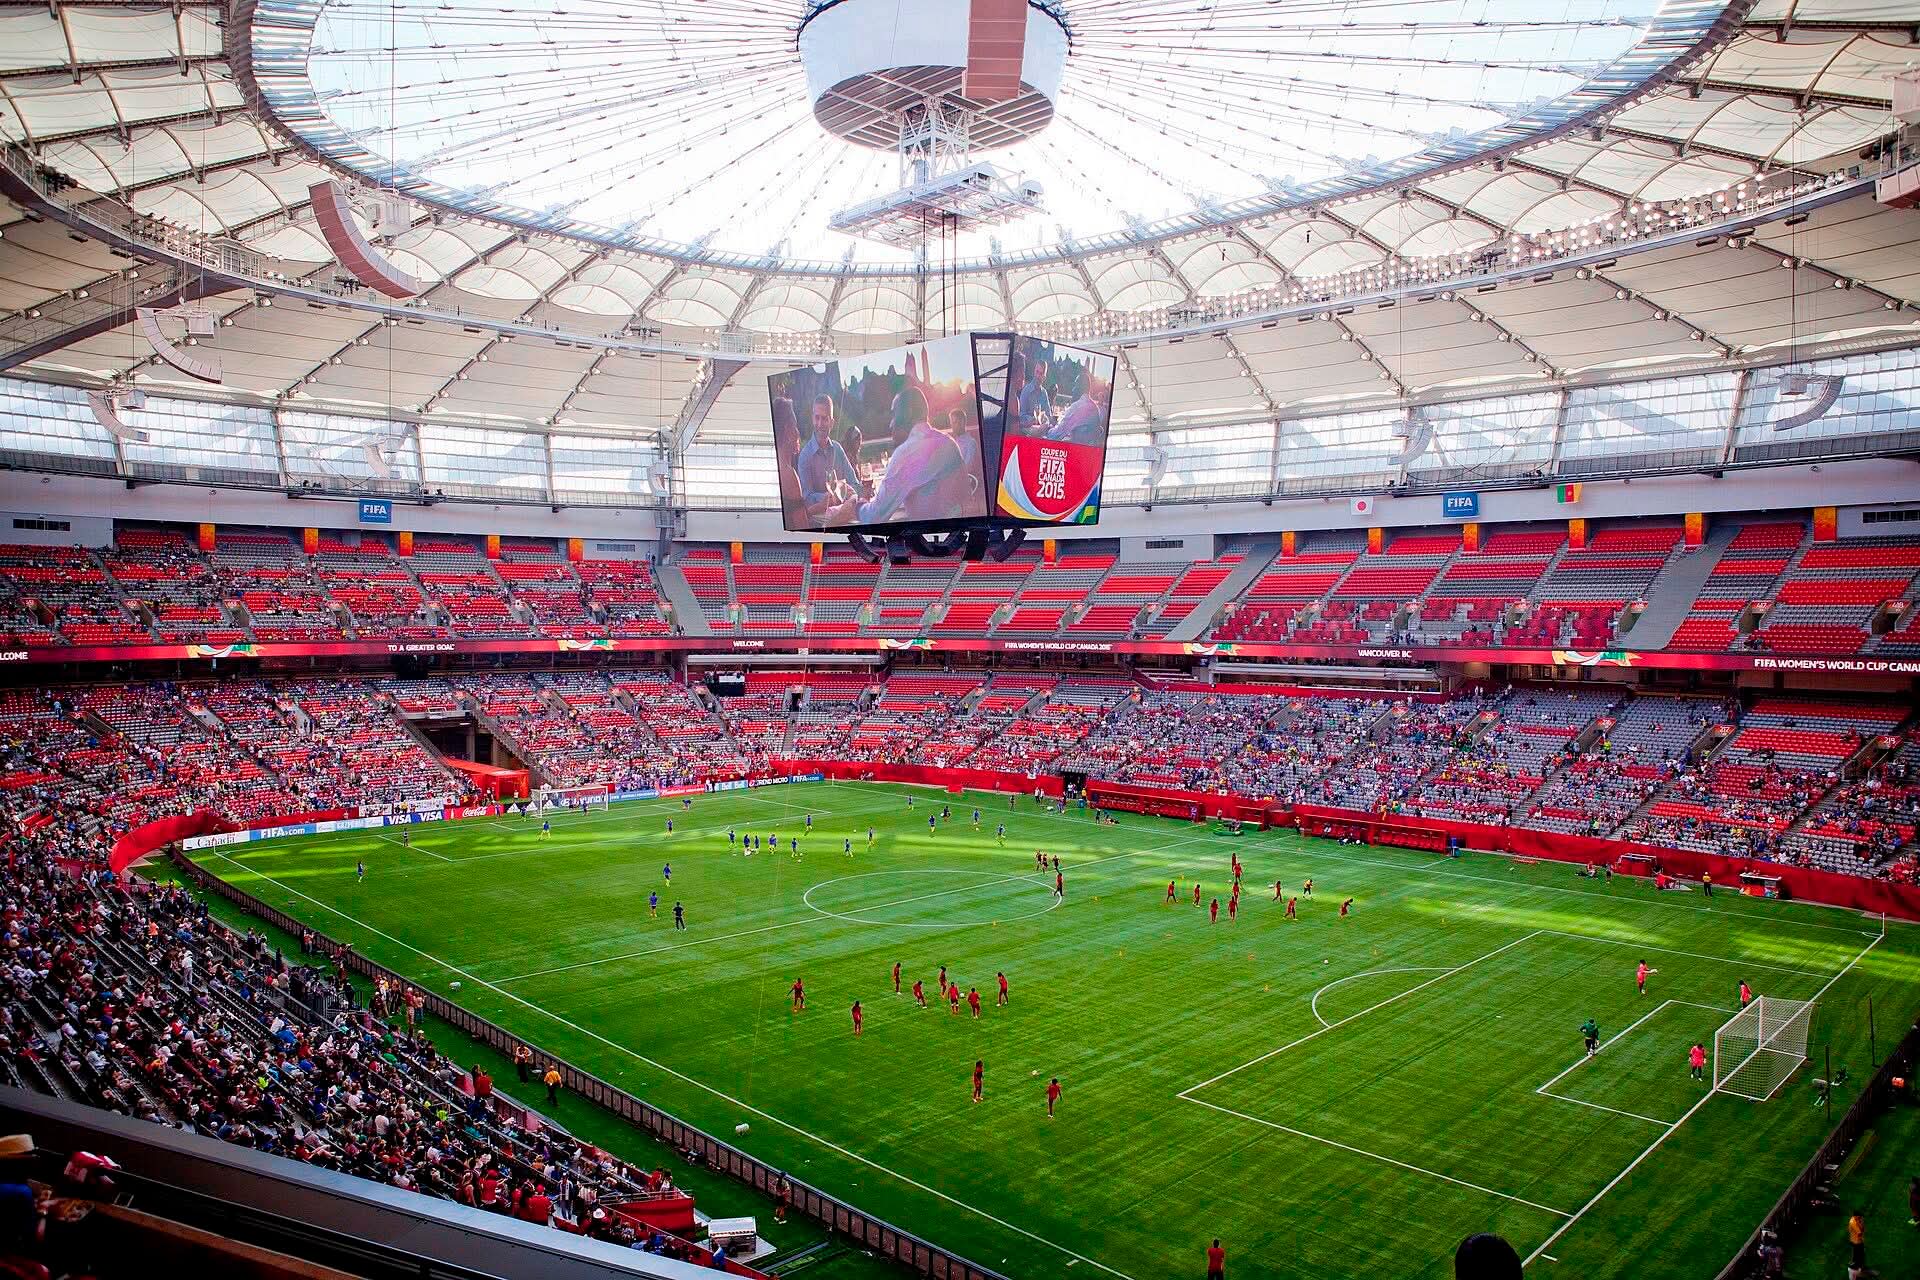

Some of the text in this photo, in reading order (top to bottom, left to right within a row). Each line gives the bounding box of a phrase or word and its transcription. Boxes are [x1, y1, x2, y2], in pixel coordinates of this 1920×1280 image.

[1041, 448, 1059, 456] COUPE
[1059, 449, 1067, 458] DU
[1039, 458, 1065, 475] FIFA
[1038, 472, 1065, 483] CANADA
[1036, 480, 1065, 500] 2015
[1447, 497, 1473, 508] FIFA
[363, 504, 387, 514] FIFA
[1358, 649, 1412, 658] VANCOUVER BC
[1755, 658, 1776, 668] FIFA
[1777, 660, 1825, 669] WOMEN'S
[1826, 661, 1864, 670] WORLD
[1866, 662, 1889, 671] CUP
[389, 813, 412, 825] VISA
[419, 810, 443, 822] VISA
[261, 827, 305, 839] FIFA.com
[197, 834, 235, 847] Canada
